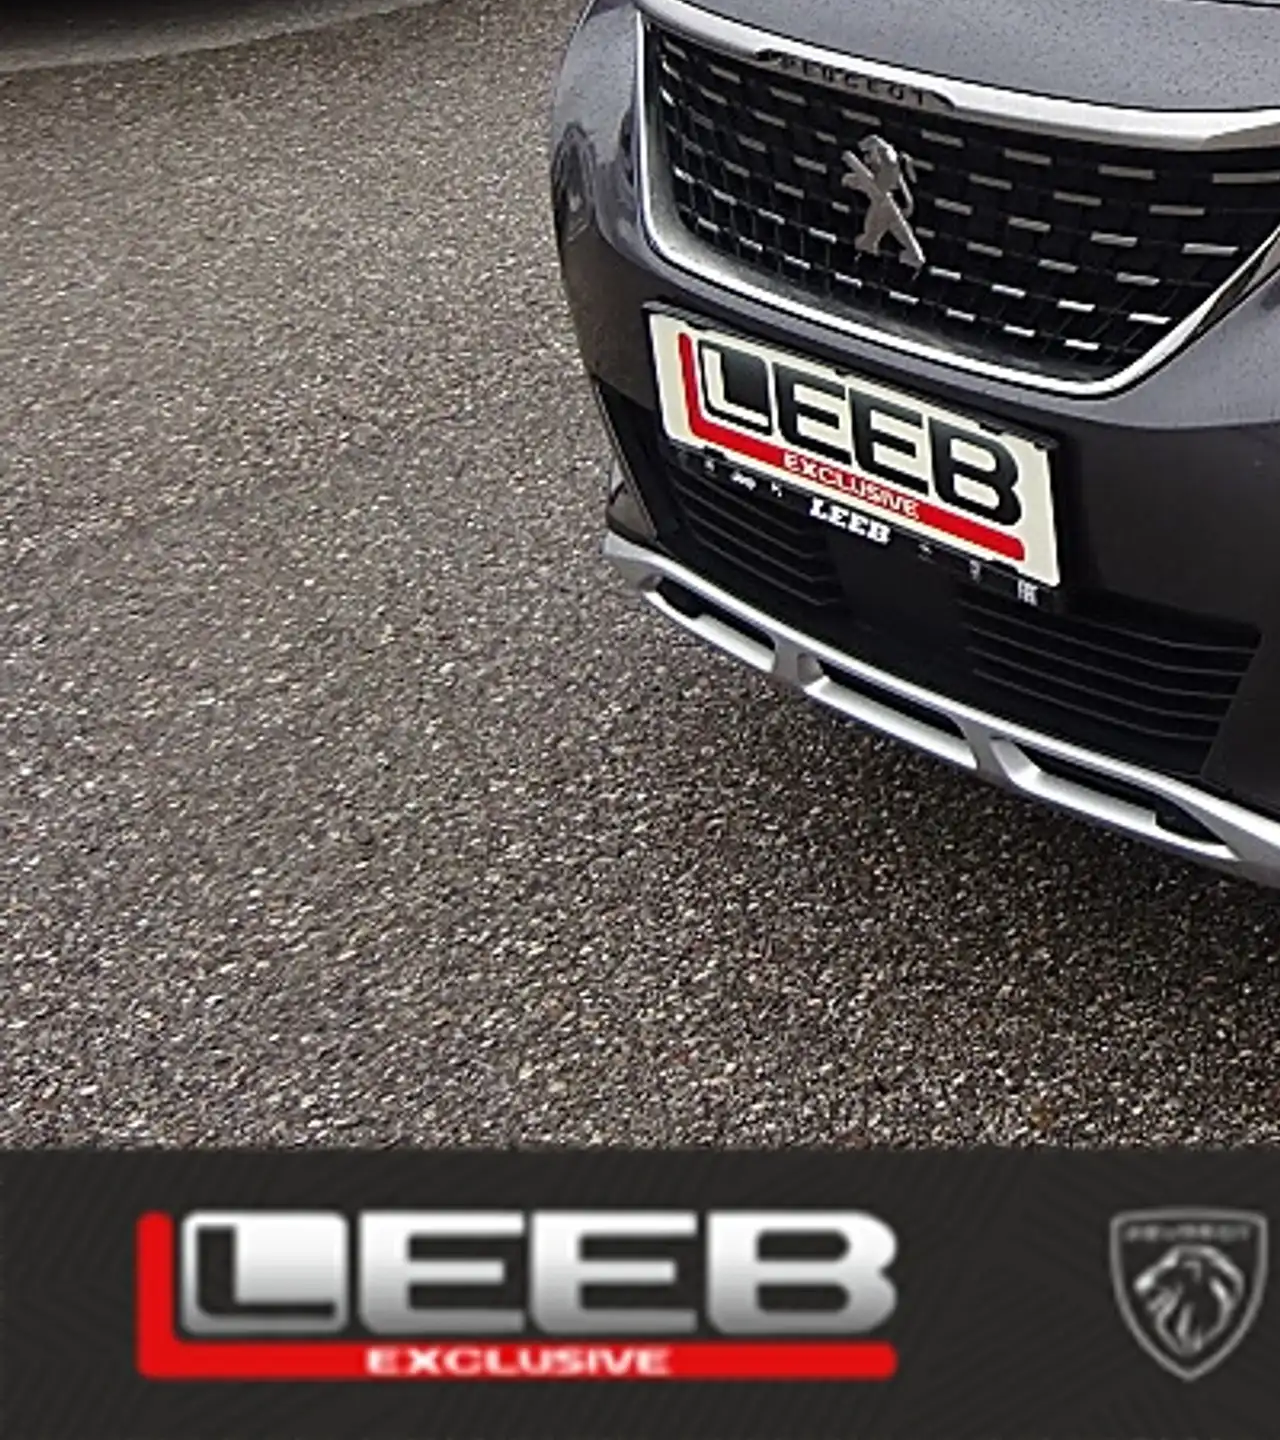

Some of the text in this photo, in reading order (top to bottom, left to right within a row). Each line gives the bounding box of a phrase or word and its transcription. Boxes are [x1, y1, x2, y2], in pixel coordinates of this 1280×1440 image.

[699, 338, 1023, 526] LEEB
[783, 451, 919, 520] EXCLUSIVE
[810, 497, 891, 546] LEEB
